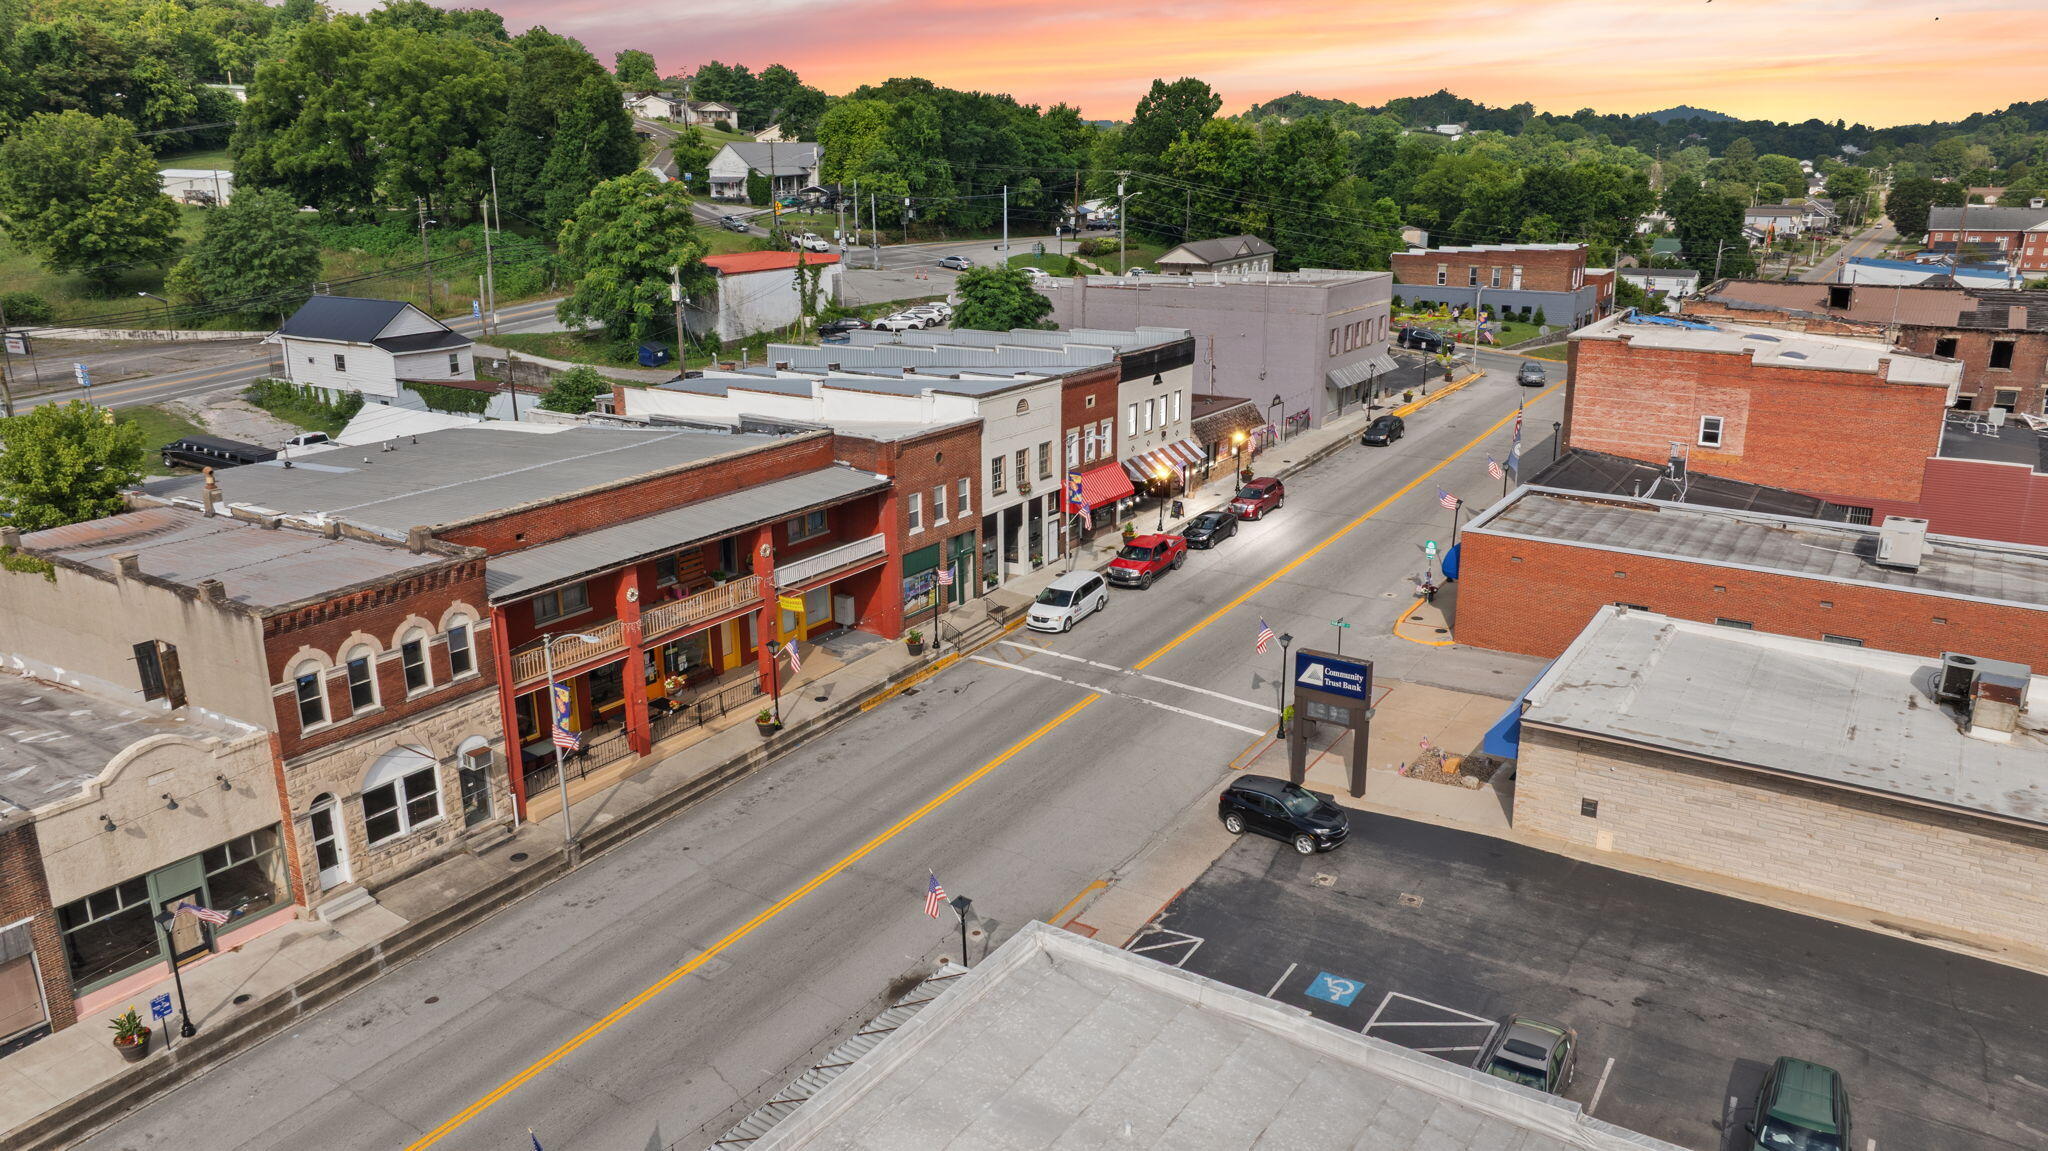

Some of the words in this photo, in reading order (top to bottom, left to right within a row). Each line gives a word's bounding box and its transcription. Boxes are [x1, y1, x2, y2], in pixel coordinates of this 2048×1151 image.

[1324, 667, 1364, 683] Community
[1324, 678, 1342, 687] Trust
[1342, 682, 1362, 692] Bank
